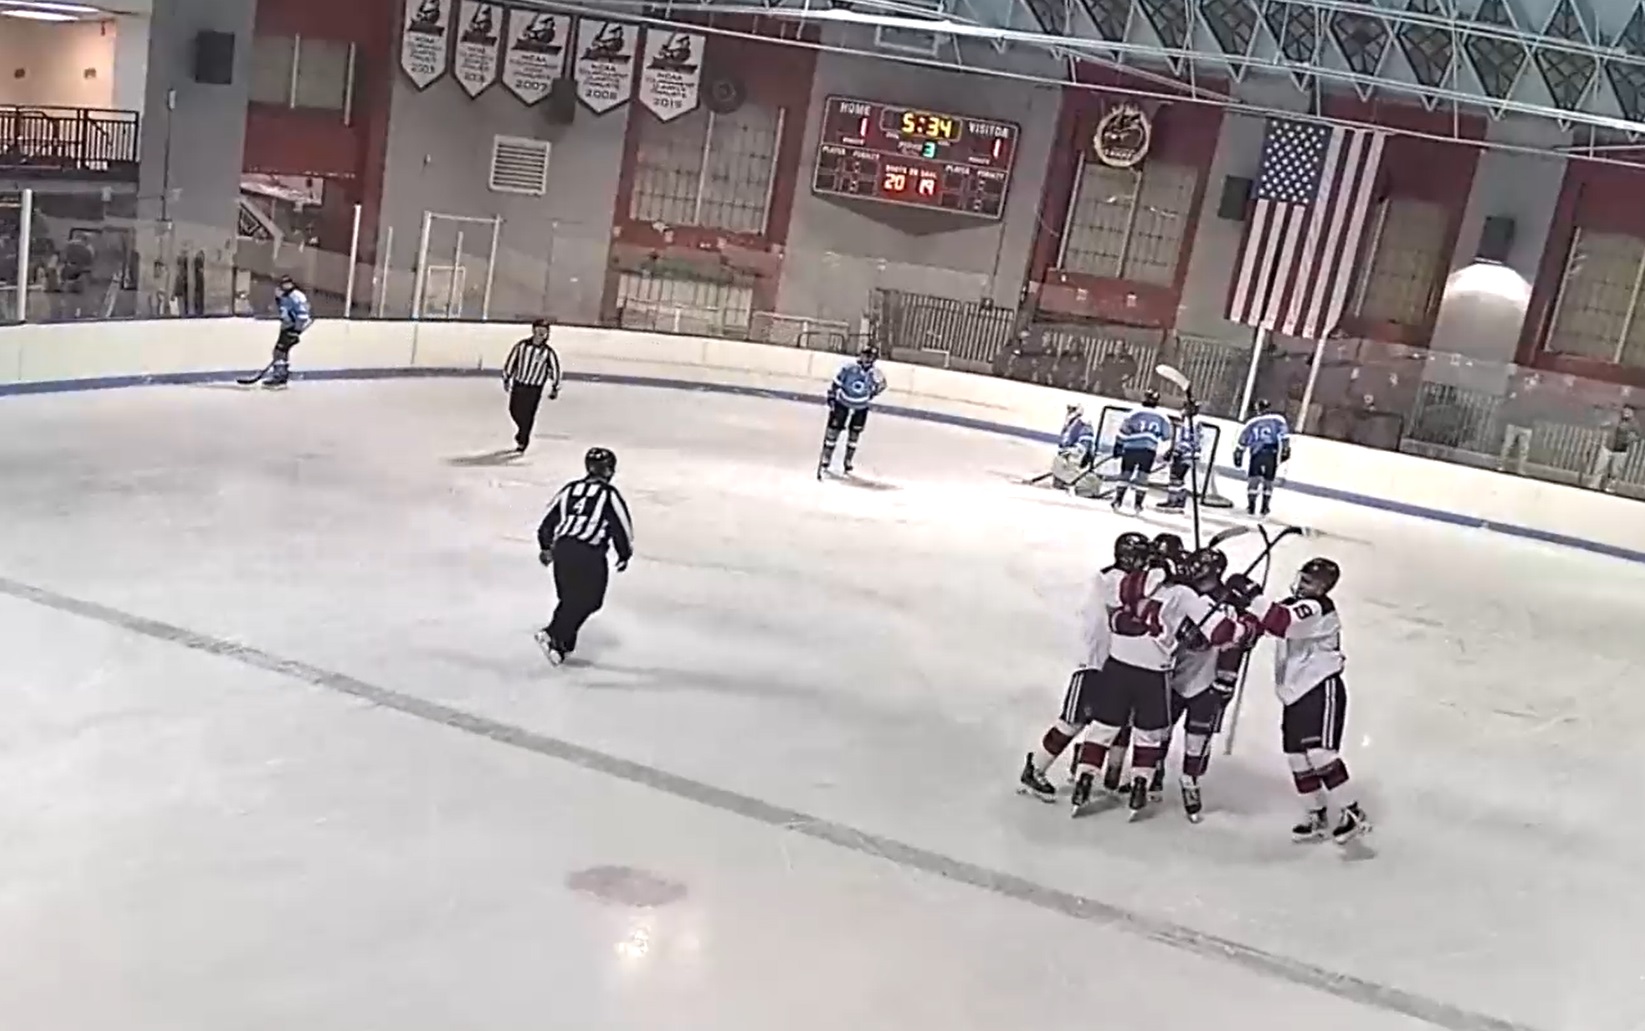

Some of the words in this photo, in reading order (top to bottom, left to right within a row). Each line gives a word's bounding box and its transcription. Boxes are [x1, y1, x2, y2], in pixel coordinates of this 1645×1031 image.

[515, 79, 549, 92] 2007
[656, 72, 683, 81] NCAA
[840, 102, 871, 116] HOME
[860, 117, 868, 137] 1
[902, 114, 952, 138] 5:34
[969, 122, 1009, 138] VISITOR
[923, 141, 936, 158] 3
[993, 138, 1001, 160] 1
[883, 173, 906, 192] 20
[918, 177, 935, 196] 19
